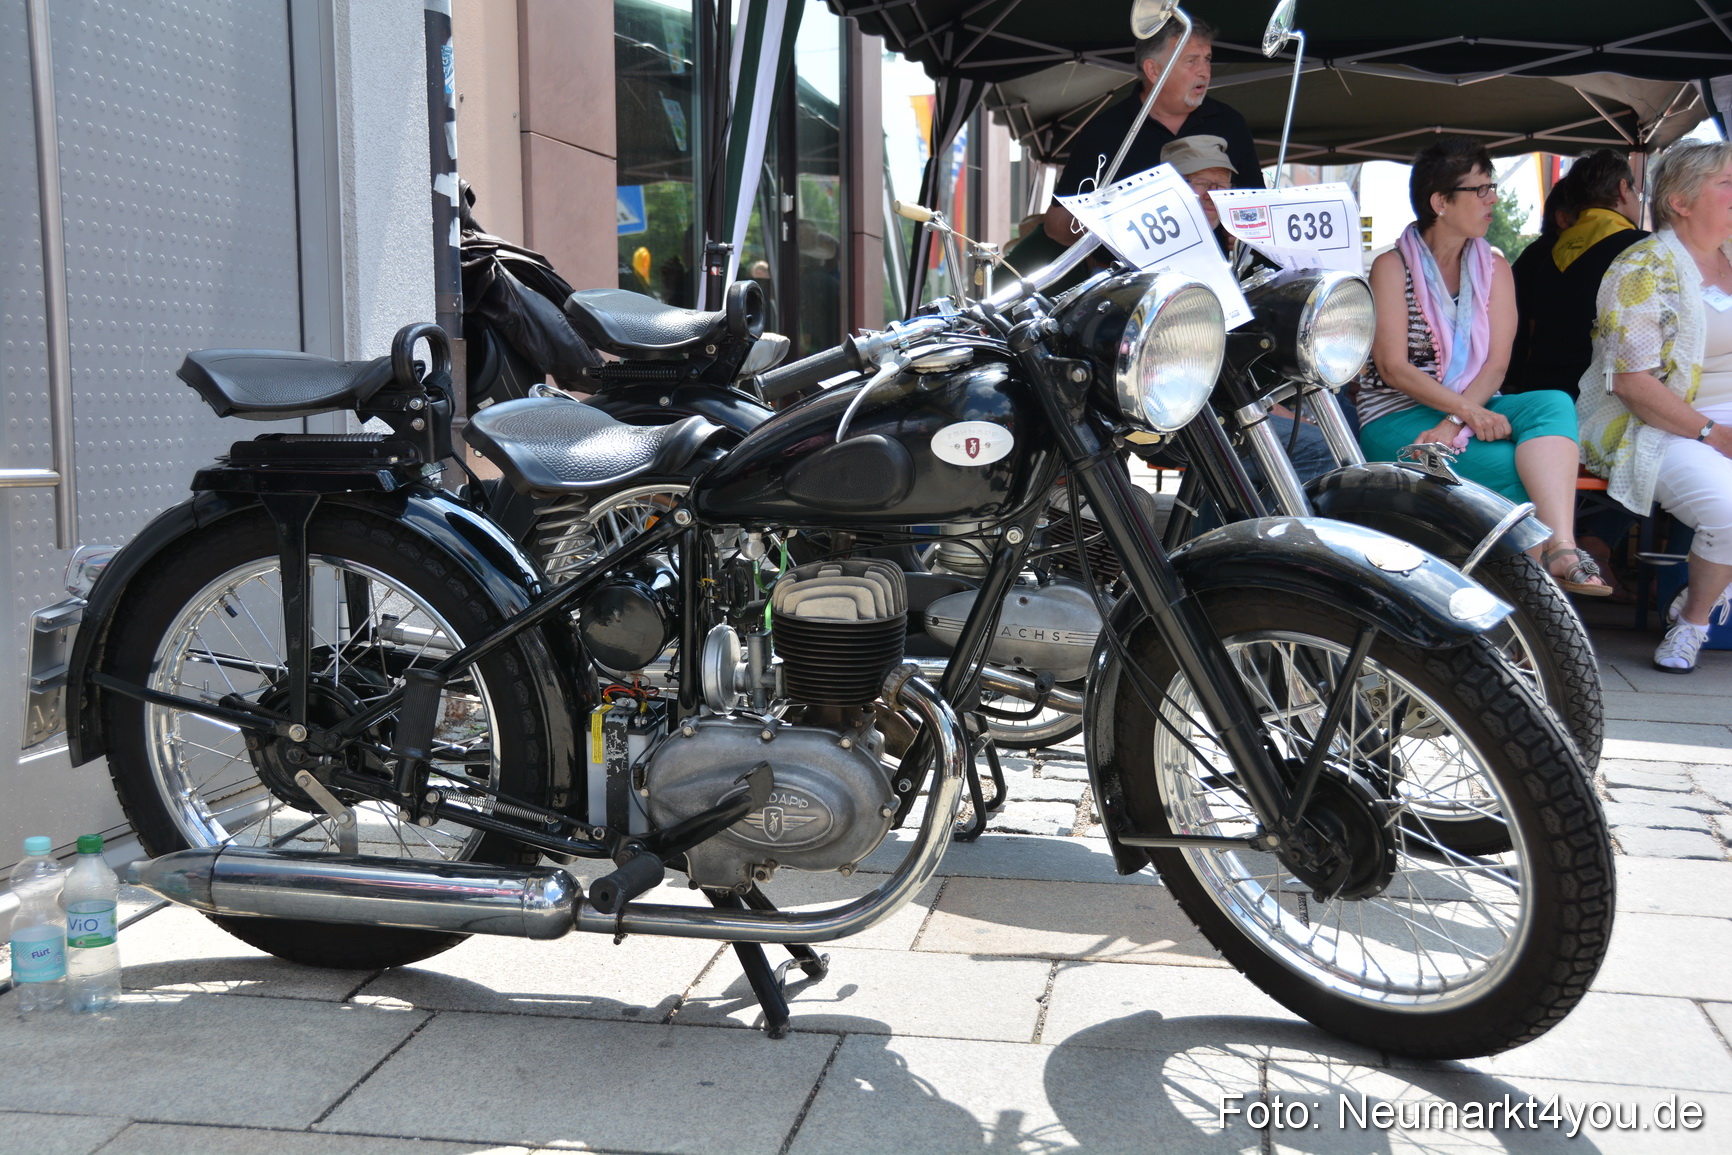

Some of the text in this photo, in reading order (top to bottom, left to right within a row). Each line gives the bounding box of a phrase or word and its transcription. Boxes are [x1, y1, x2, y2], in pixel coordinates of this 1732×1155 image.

[1126, 205, 1180, 250] 185
[1287, 211, 1333, 242] 638
[68, 917, 99, 931] ViO
[31, 948, 51, 959] Flirt
